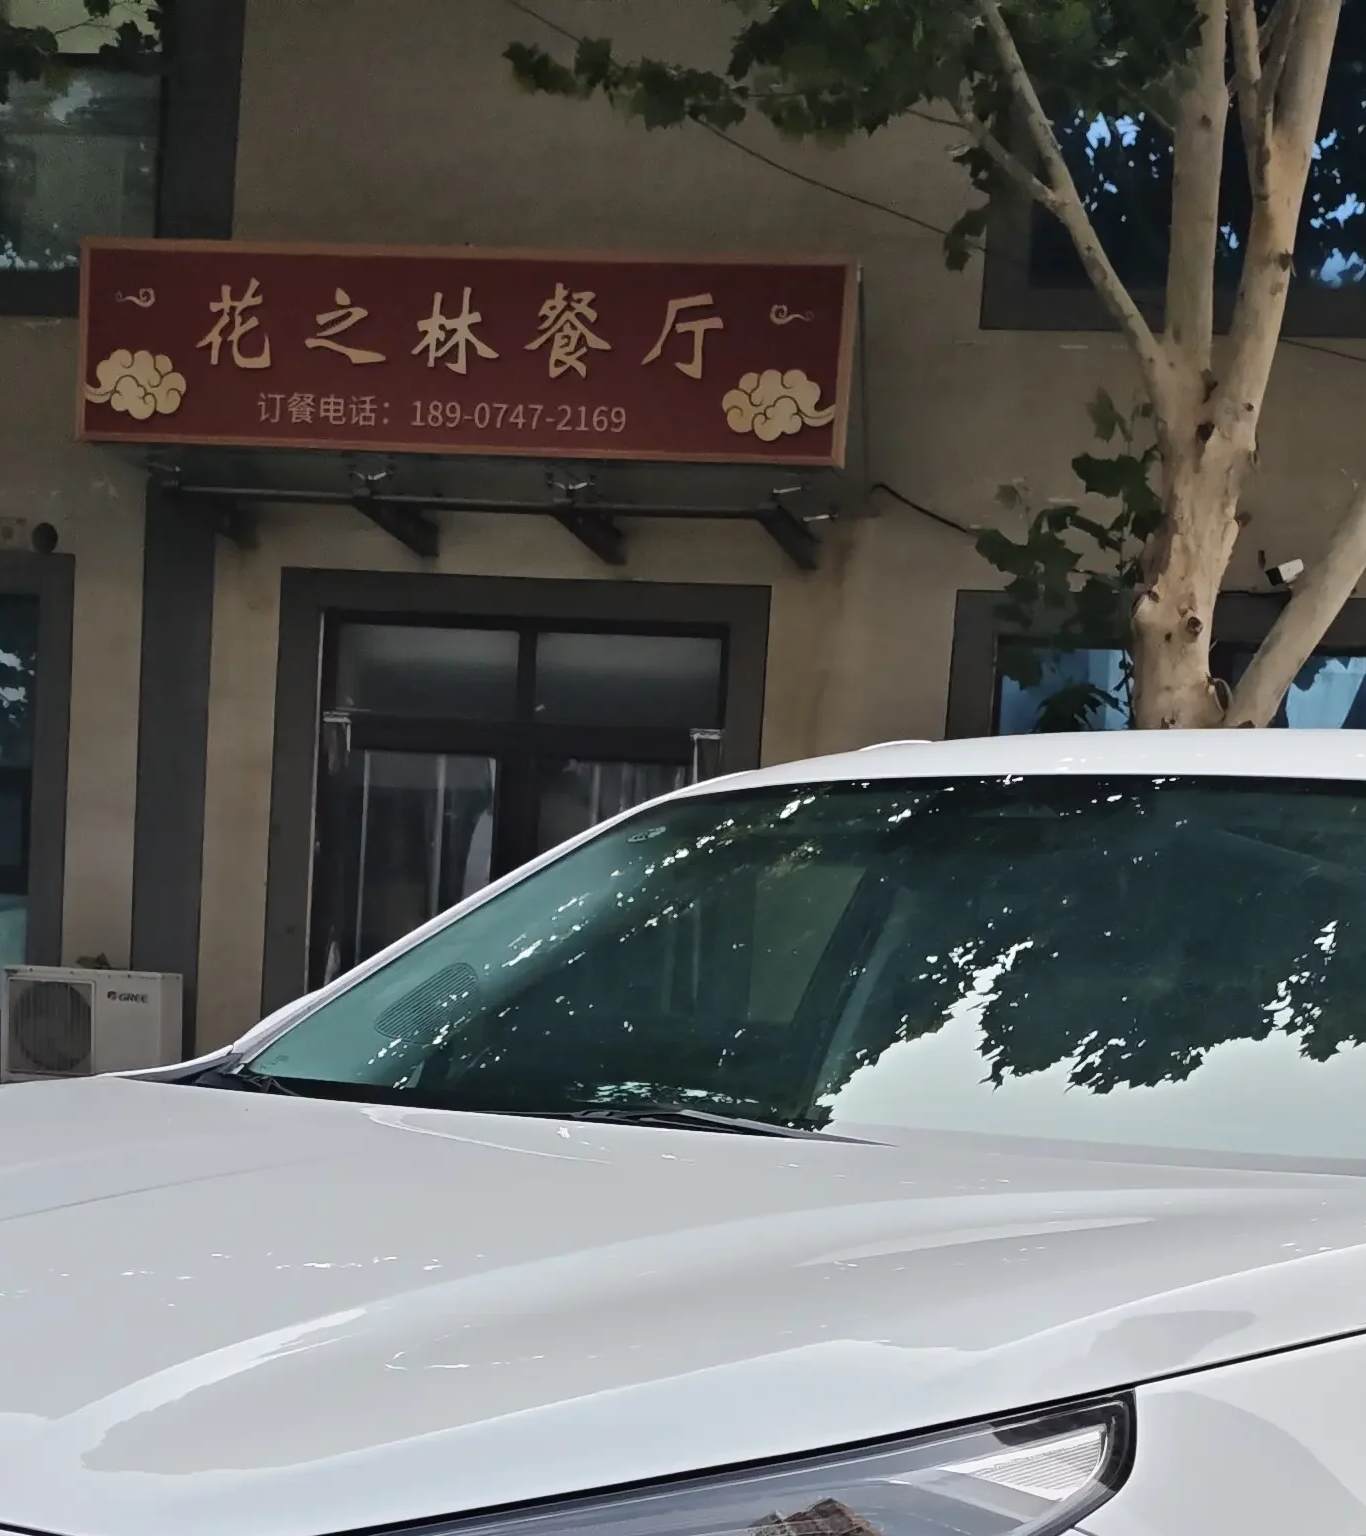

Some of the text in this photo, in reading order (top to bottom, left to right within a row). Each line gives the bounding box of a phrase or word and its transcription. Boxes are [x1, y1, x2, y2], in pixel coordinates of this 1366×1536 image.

[195, 276, 724, 379] 花之林餐厅
